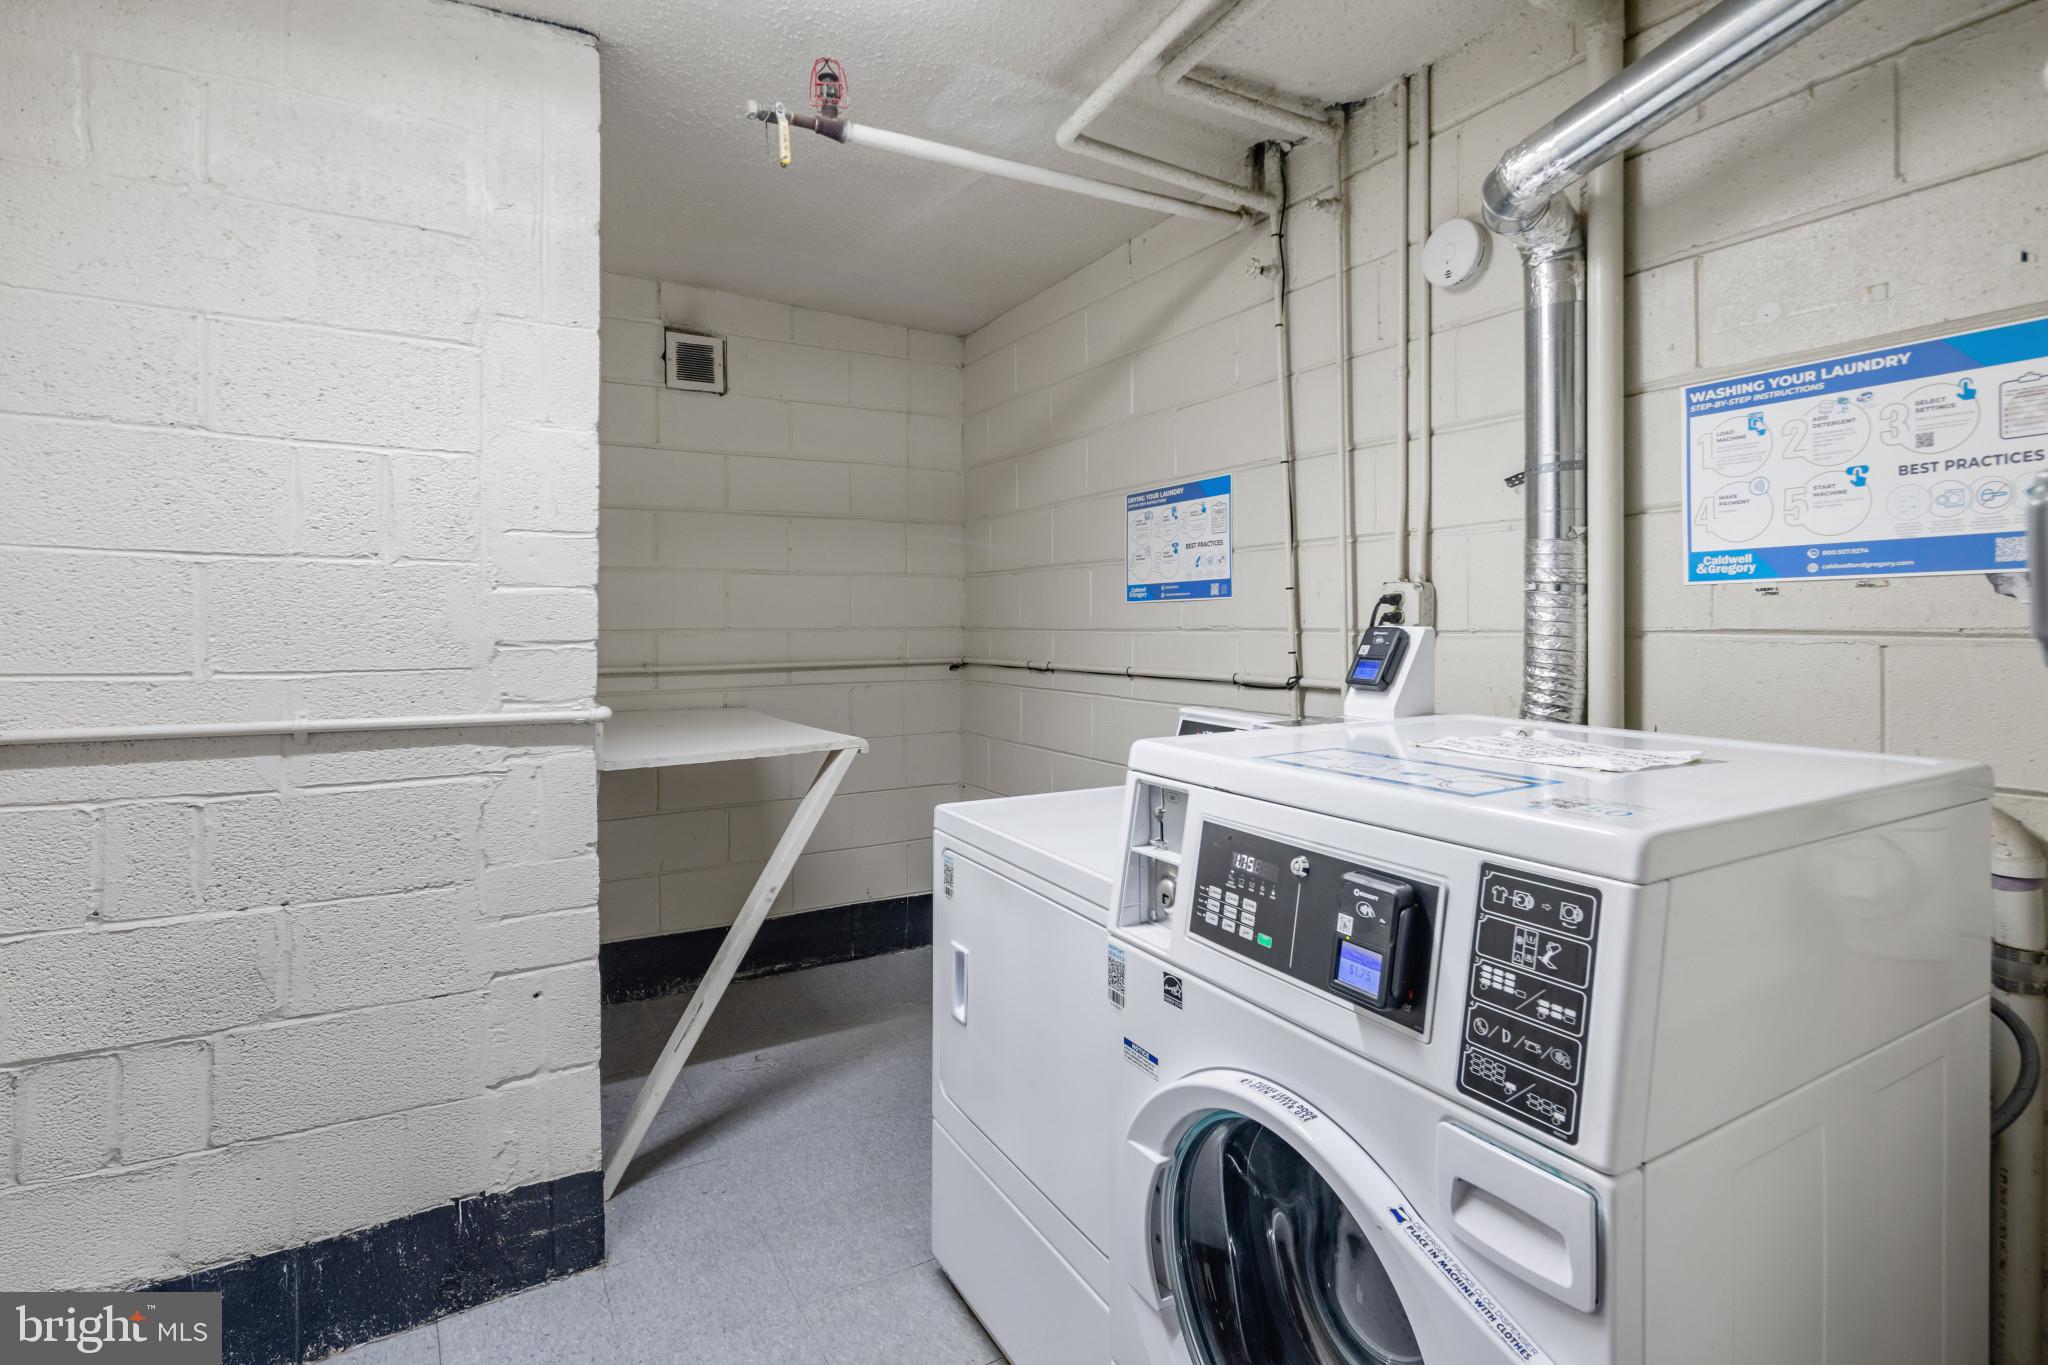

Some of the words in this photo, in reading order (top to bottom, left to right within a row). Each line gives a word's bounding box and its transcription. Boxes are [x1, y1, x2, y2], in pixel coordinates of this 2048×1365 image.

[1690, 380, 1765, 403] WASHING
[1769, 370, 1816, 389] YOUR
[1821, 352, 1912, 380] LAUNDRY
[1690, 395, 1752, 413] STEP-BY-STEP
[1753, 382, 1825, 402] INSTRUCTIONS
[1915, 396, 1946, 406] SELECT
[1915, 403, 1956, 414] SETTINGS
[1812, 417, 1857, 429] DETERGENT
[1879, 402, 1910, 447] 3
[1716, 429, 1734, 437] LOAD
[1716, 434, 1746, 443] MACHINE
[1781, 418, 1809, 460] 2
[1898, 461, 1940, 476] BEST
[1945, 449, 2045, 471] PRACTICES
[1146, 492, 1160, 500] YOUR
[1160, 487, 1184, 498] LAUNDRY
[1812, 483, 1836, 491] START
[1812, 489, 1848, 497] MACHINE
[1718, 499, 1750, 507] PAYMENT
[1784, 486, 1809, 527] 5
[1694, 495, 1718, 534] 4
[1197, 539, 1223, 548] PRACTICES
[1703, 553, 1753, 566] Caldwell
[1696, 563, 1757, 575] &Gregory
[1256, 1082, 1279, 1093] PLEASE
[1277, 1092, 1298, 1105] LEAVE
[1296, 1104, 1318, 1120] DOOR
[1270, 1094, 1294, 1110] AFTER
[1294, 1110, 1312, 1122] USE
[1406, 1225, 1430, 1249] PLACE
[1427, 1248, 1440, 1260] IN
[1438, 1259, 1476, 1299] MACHINE
[1474, 1298, 1498, 1323] WITH
[1496, 1322, 1533, 1361] CLOTHES
[1413, 1221, 1453, 1263] DETERGENT
[1452, 1263, 1476, 1288] PACKS
[1474, 1287, 1496, 1310] CLOG
[1494, 1310, 1539, 1356] DISPENSER
